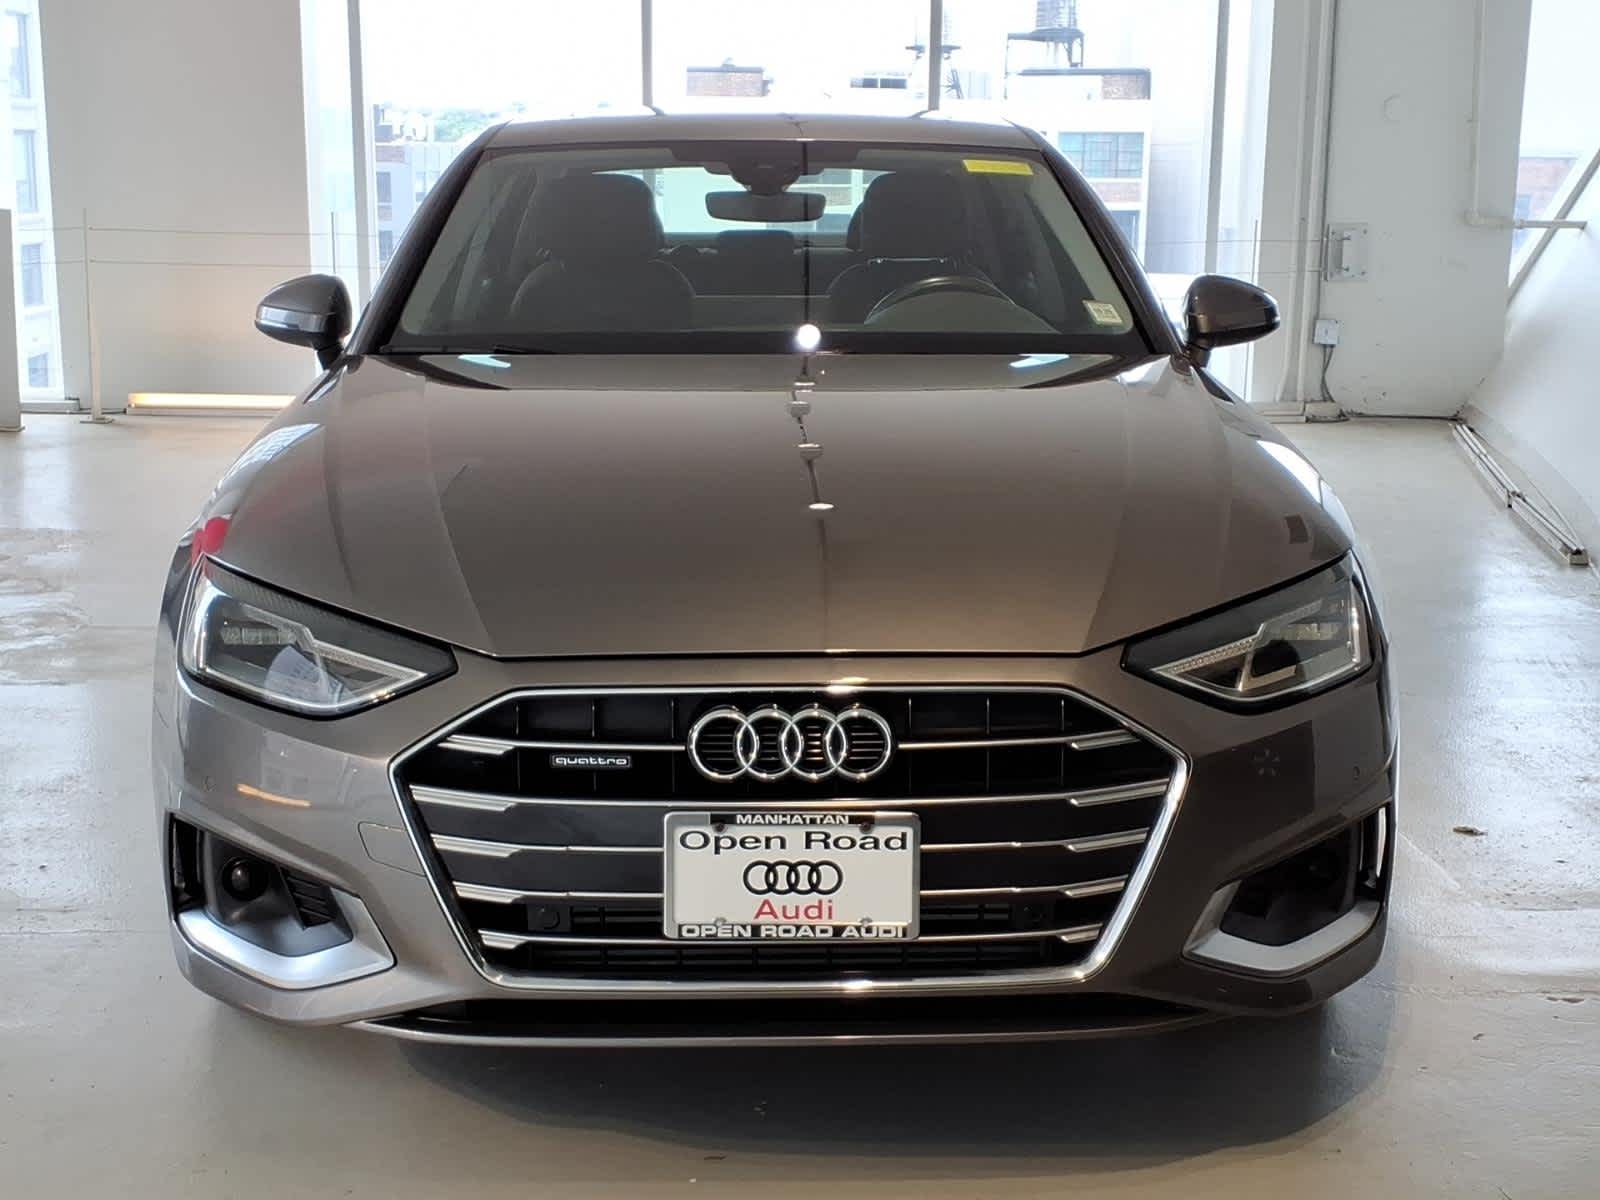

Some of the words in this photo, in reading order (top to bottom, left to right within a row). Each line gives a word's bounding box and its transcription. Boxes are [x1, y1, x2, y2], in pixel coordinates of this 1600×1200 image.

[555, 756, 627, 766] quattro
[735, 814, 850, 825] MANHATTAN
[679, 831, 787, 855] Open
[804, 831, 908, 850] Road
[754, 899, 833, 920] Audi
[681, 924, 751, 938] OPEN
[760, 924, 834, 938] ROAD
[840, 924, 904, 938] AUDI
